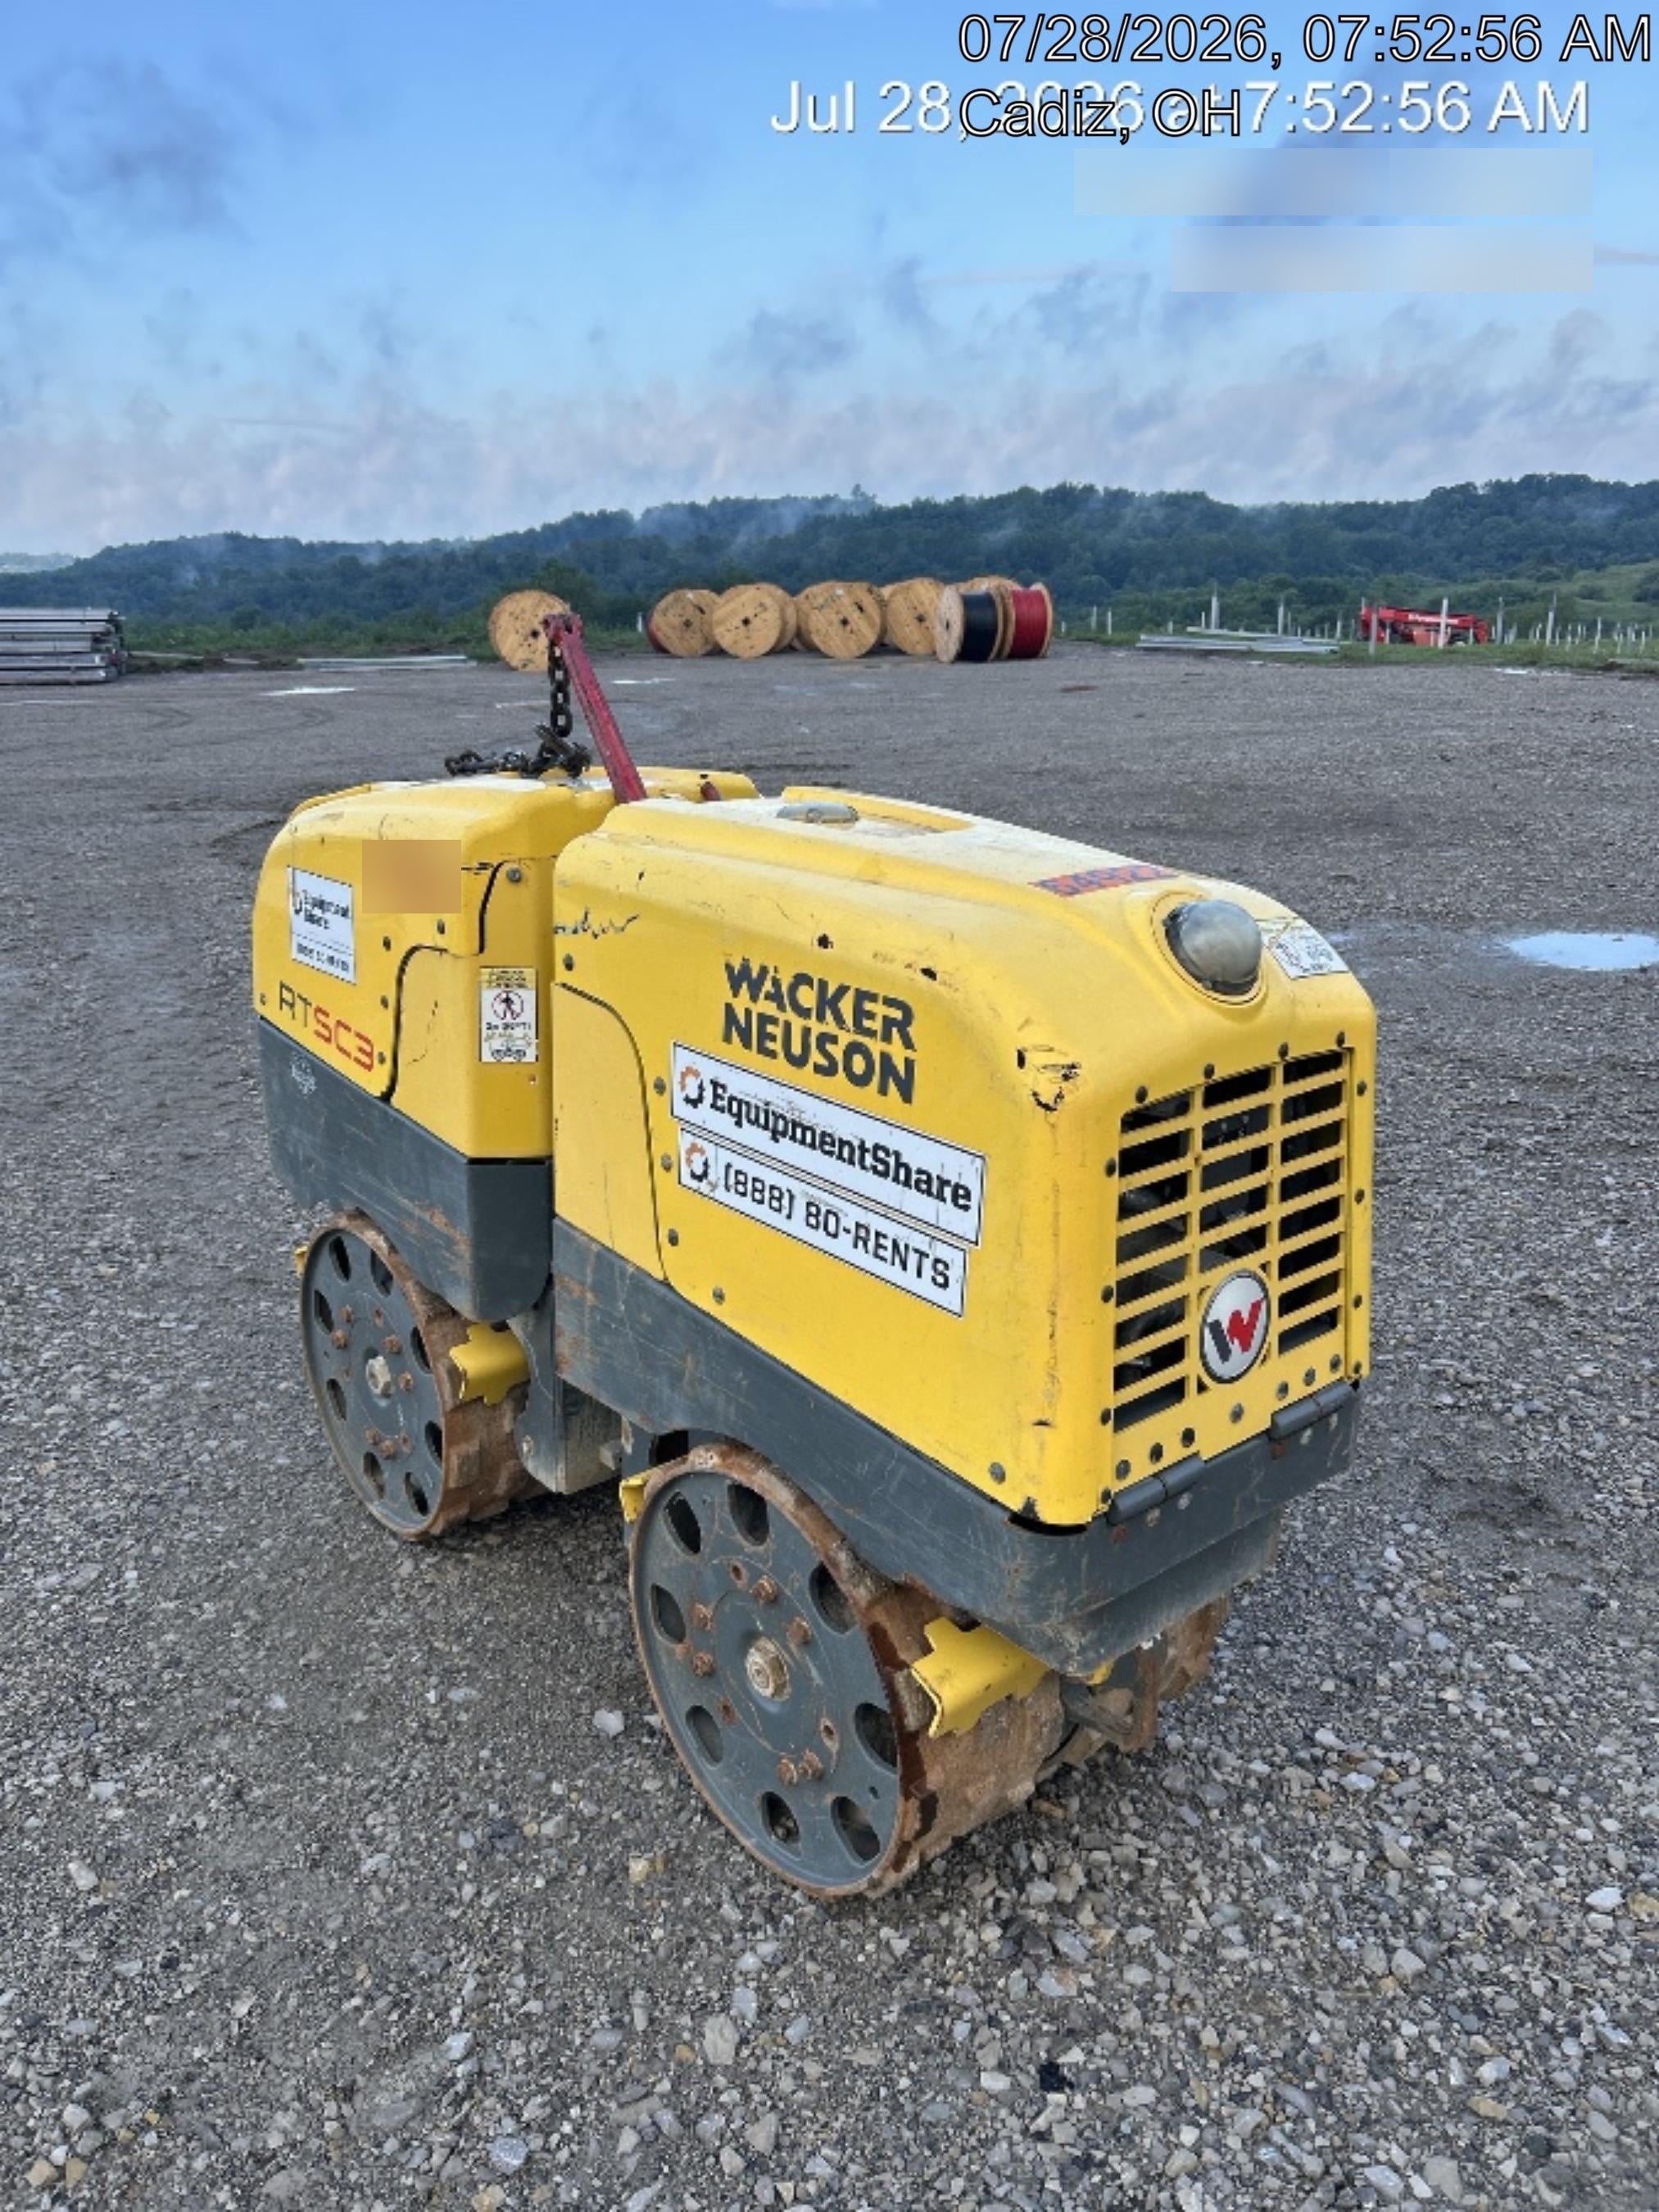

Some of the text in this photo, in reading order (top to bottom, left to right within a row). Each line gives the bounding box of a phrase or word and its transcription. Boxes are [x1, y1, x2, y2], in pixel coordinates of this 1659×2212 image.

[722, 1002, 915, 1105] NEUSON
[724, 956, 918, 1053] WACKER
[709, 1078, 972, 1213] EquipmentShare
[723, 1162, 950, 1292] (888) 80-RENTS
